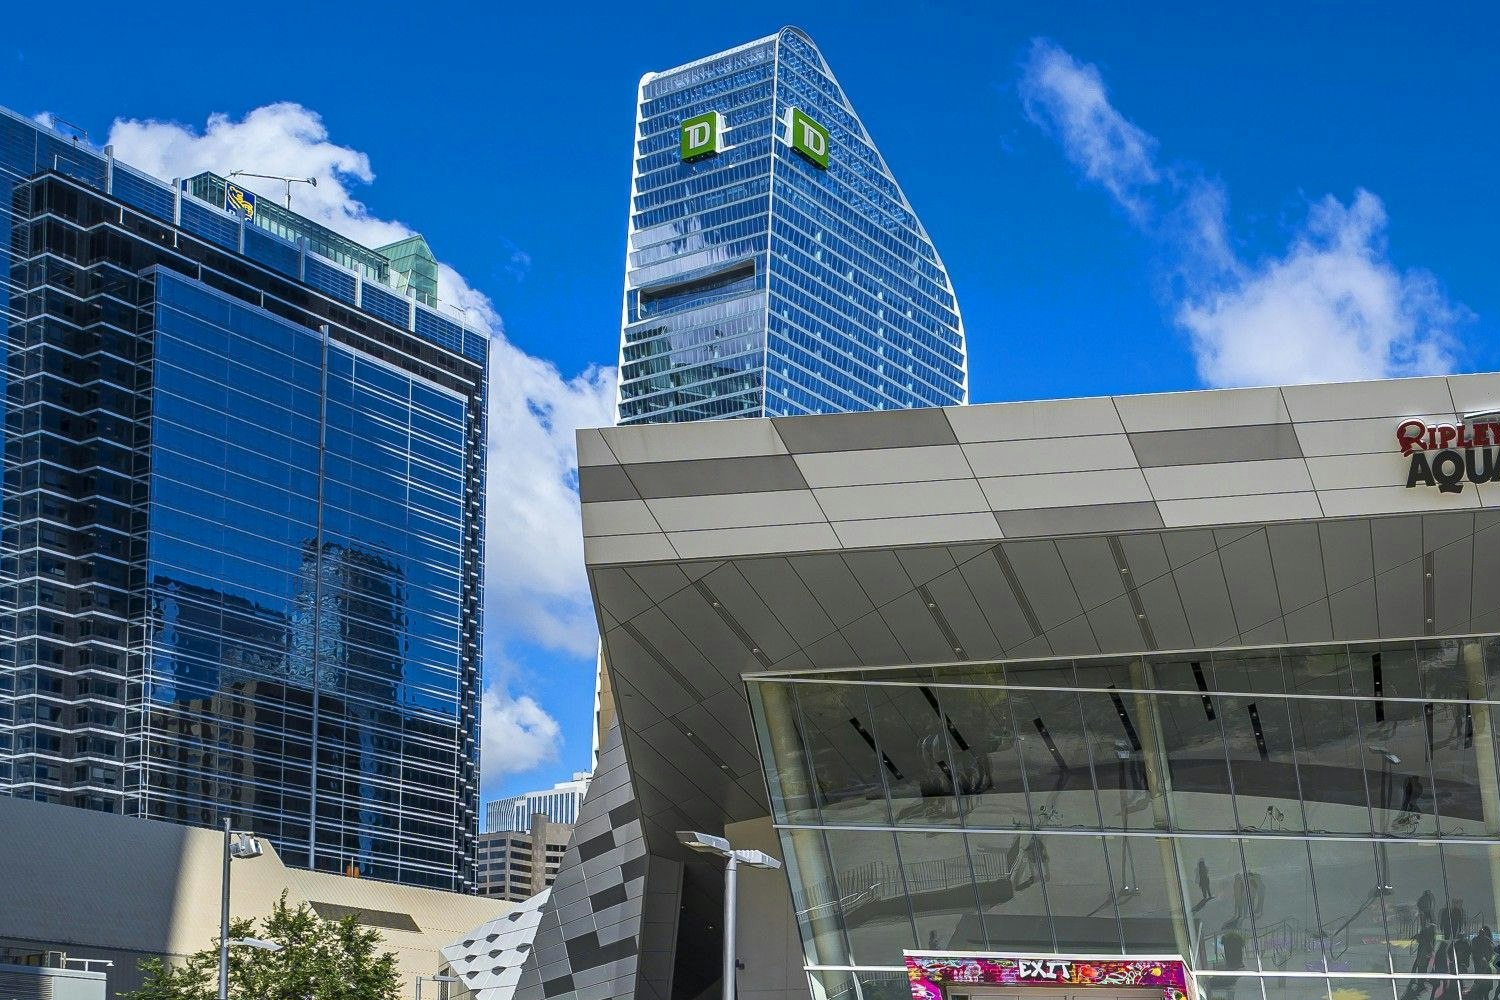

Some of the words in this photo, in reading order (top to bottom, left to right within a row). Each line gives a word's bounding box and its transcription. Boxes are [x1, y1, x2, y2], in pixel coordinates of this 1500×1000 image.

[684, 121, 711, 150] TD
[799, 118, 826, 156] TD
[1019, 959, 1071, 979] EXIT
